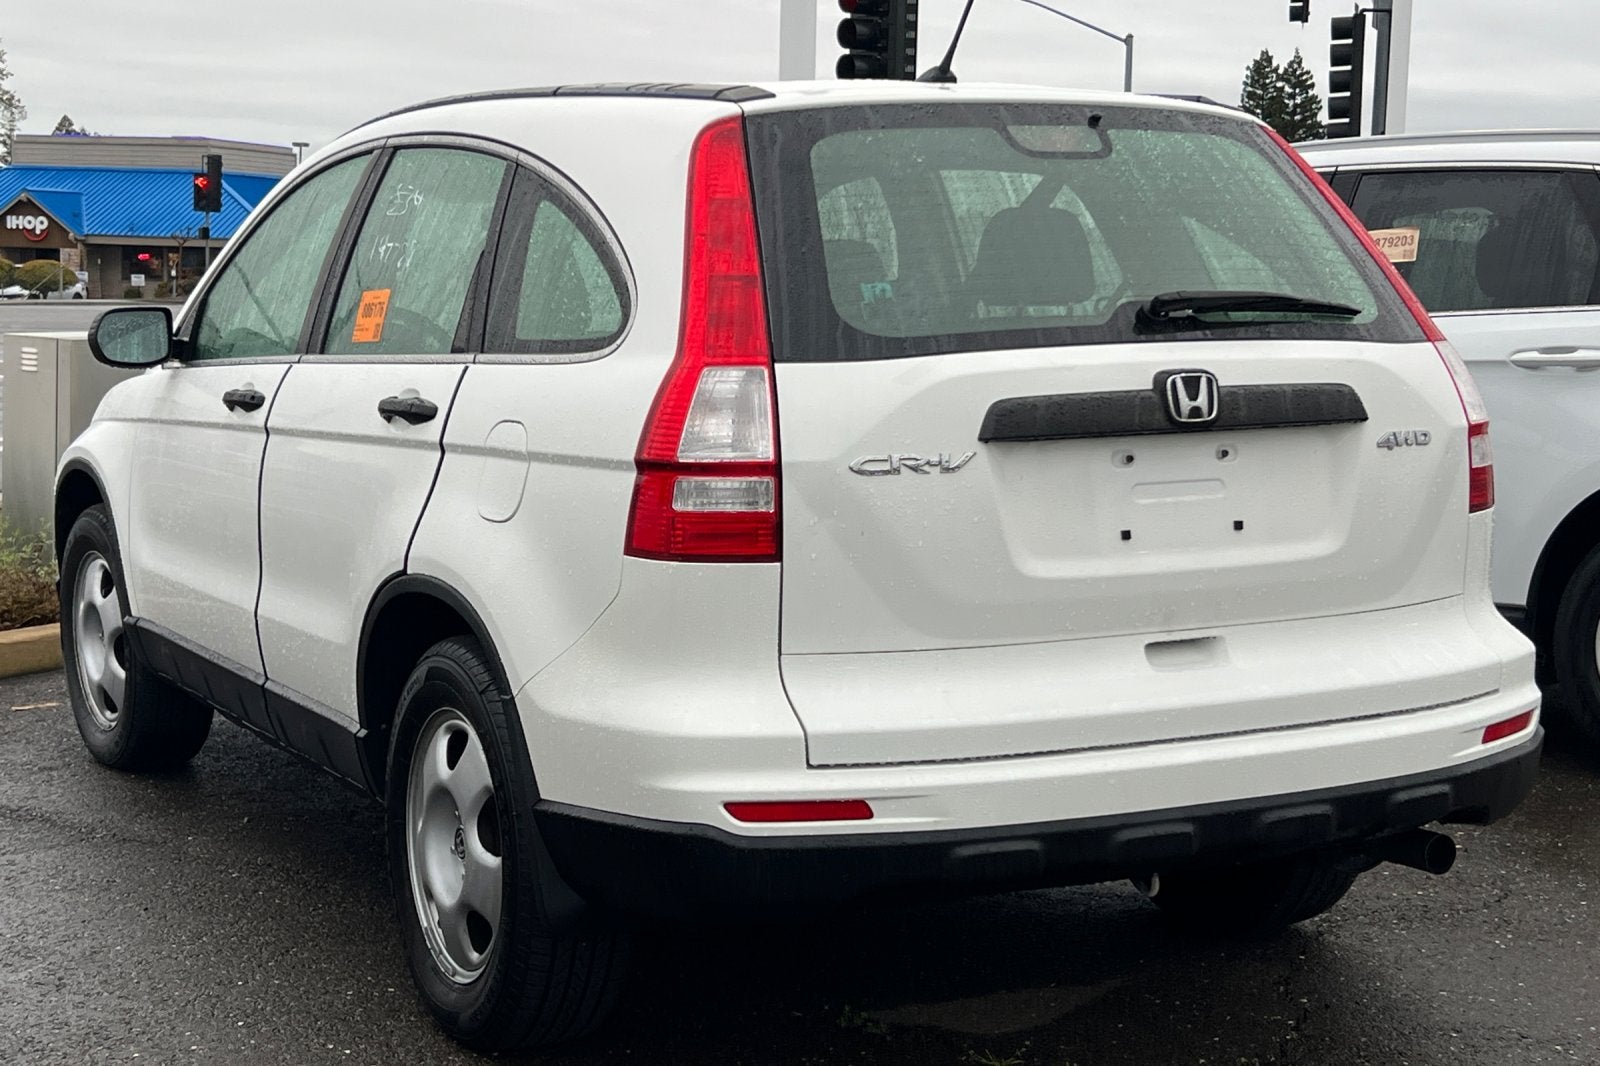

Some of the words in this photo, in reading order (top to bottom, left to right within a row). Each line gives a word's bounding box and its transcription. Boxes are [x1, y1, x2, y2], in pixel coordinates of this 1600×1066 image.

[6, 215, 49, 235] IHOP
[1376, 430, 1432, 451] 4WD
[848, 452, 977, 477] CR-V
